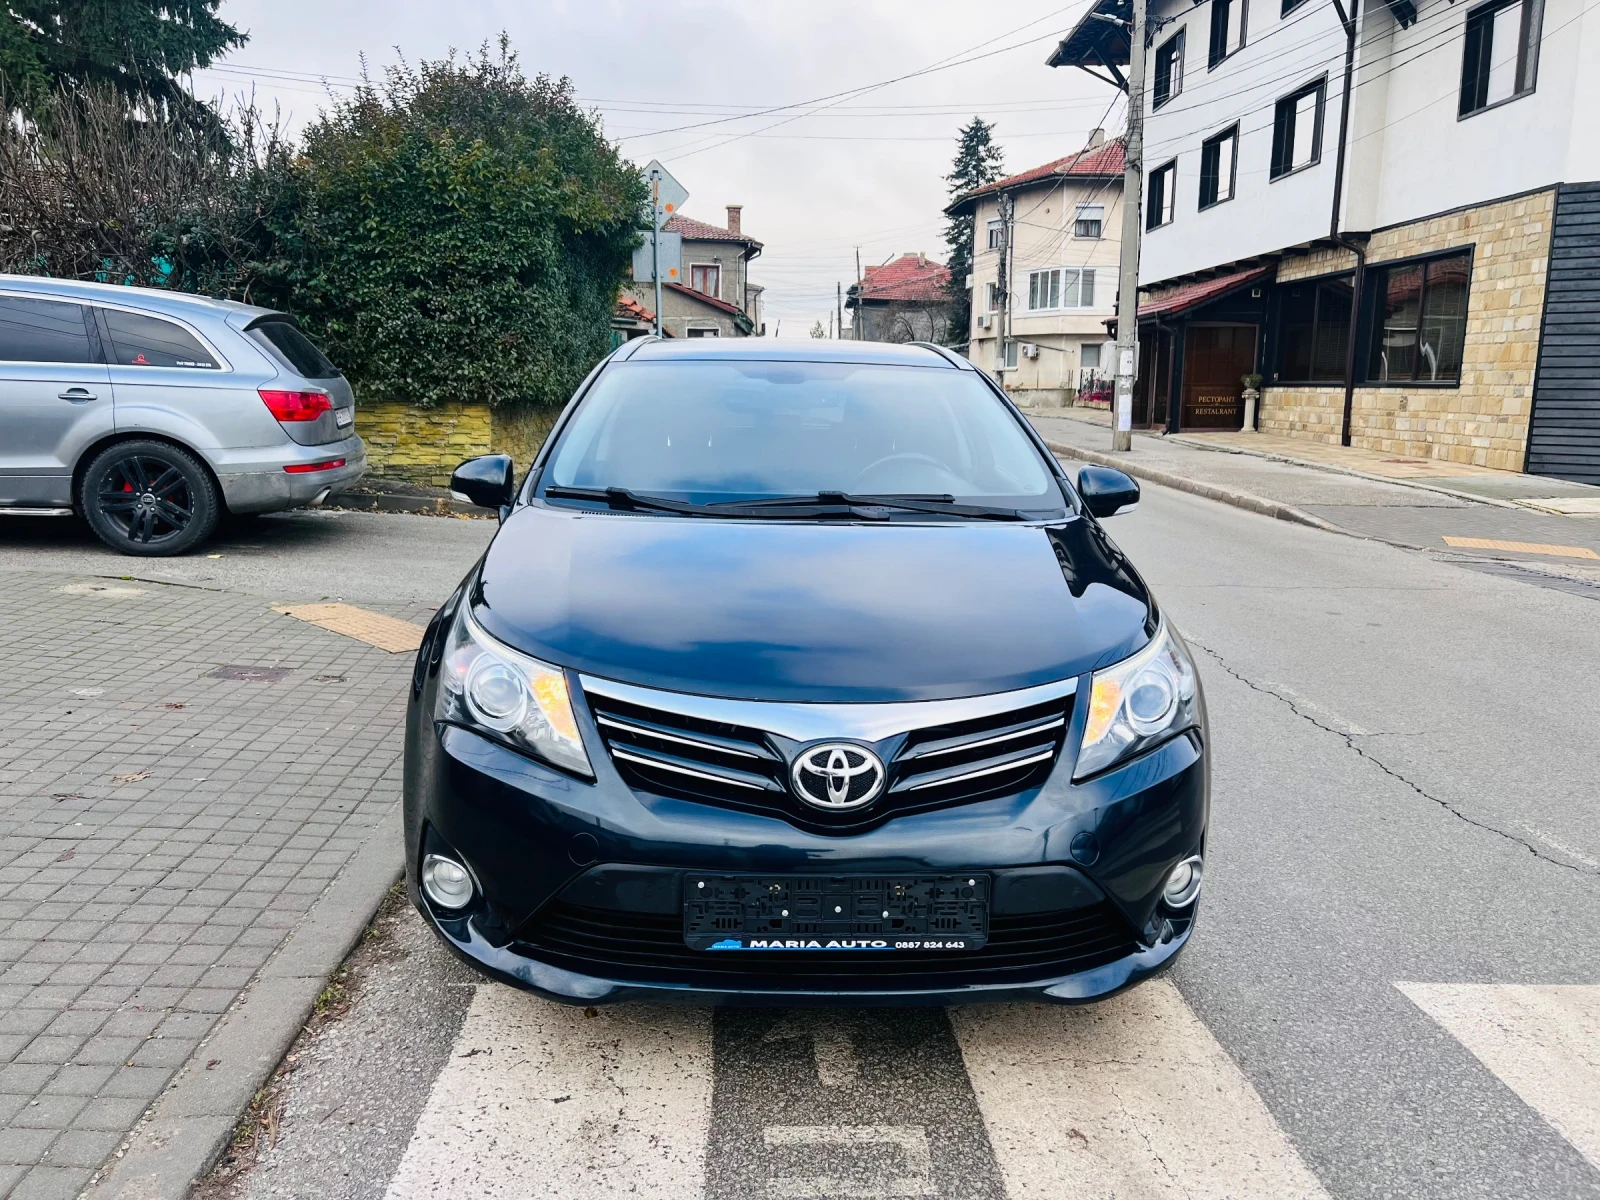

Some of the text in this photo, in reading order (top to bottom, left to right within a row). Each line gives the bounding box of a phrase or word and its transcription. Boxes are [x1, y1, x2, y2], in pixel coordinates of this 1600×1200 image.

[1198, 395, 1236, 403] РЕСТОРАНТ
[749, 940, 965, 949] MARIA AUTO 0887 824 643
